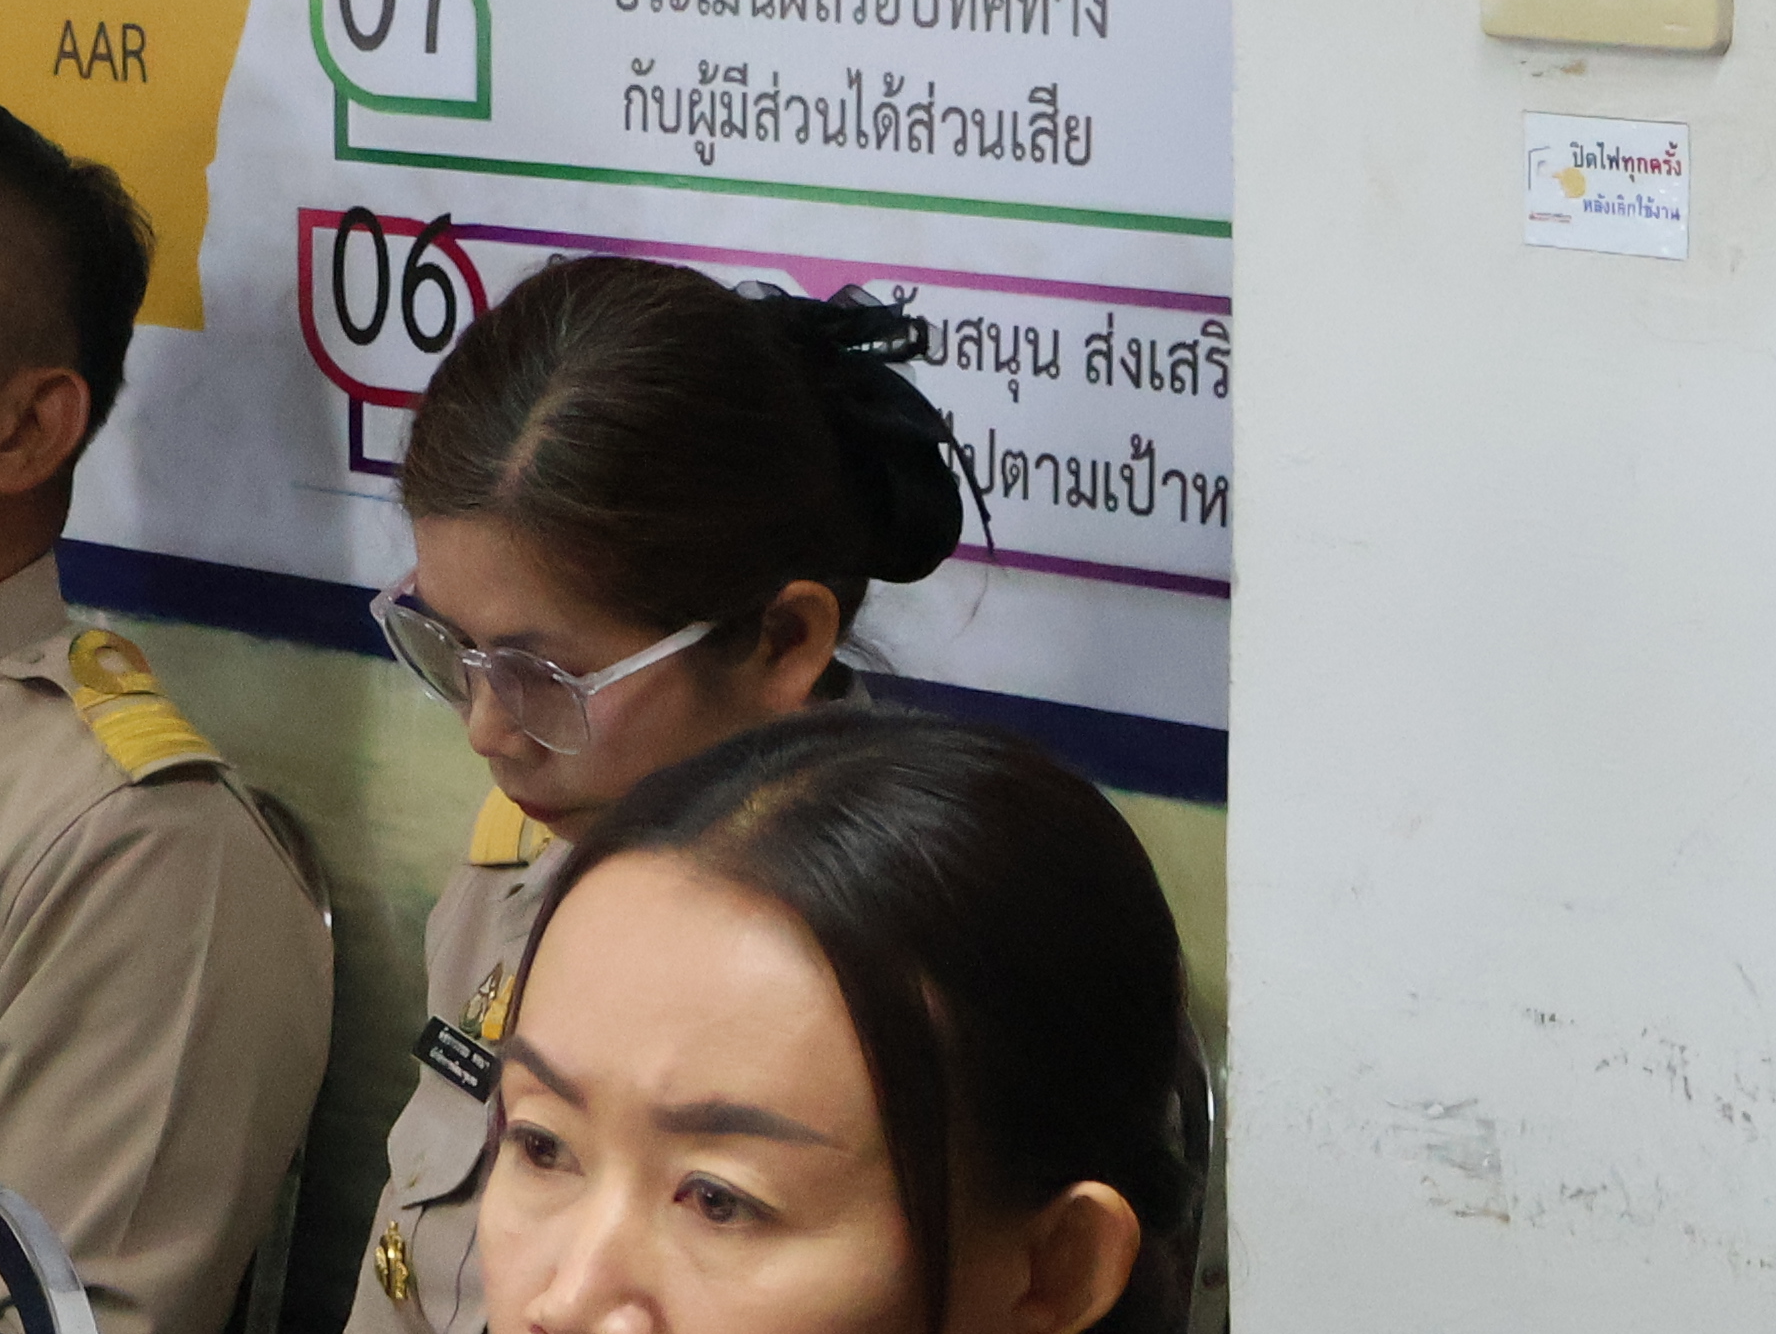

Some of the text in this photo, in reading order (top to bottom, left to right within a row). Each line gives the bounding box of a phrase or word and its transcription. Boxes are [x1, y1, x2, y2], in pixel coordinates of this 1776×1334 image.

[53, 19, 148, 84] AAR
[623, 58, 1095, 168] กับผู้มีส่วนได้ส่วนเสีย
[331, 205, 458, 355] 06
